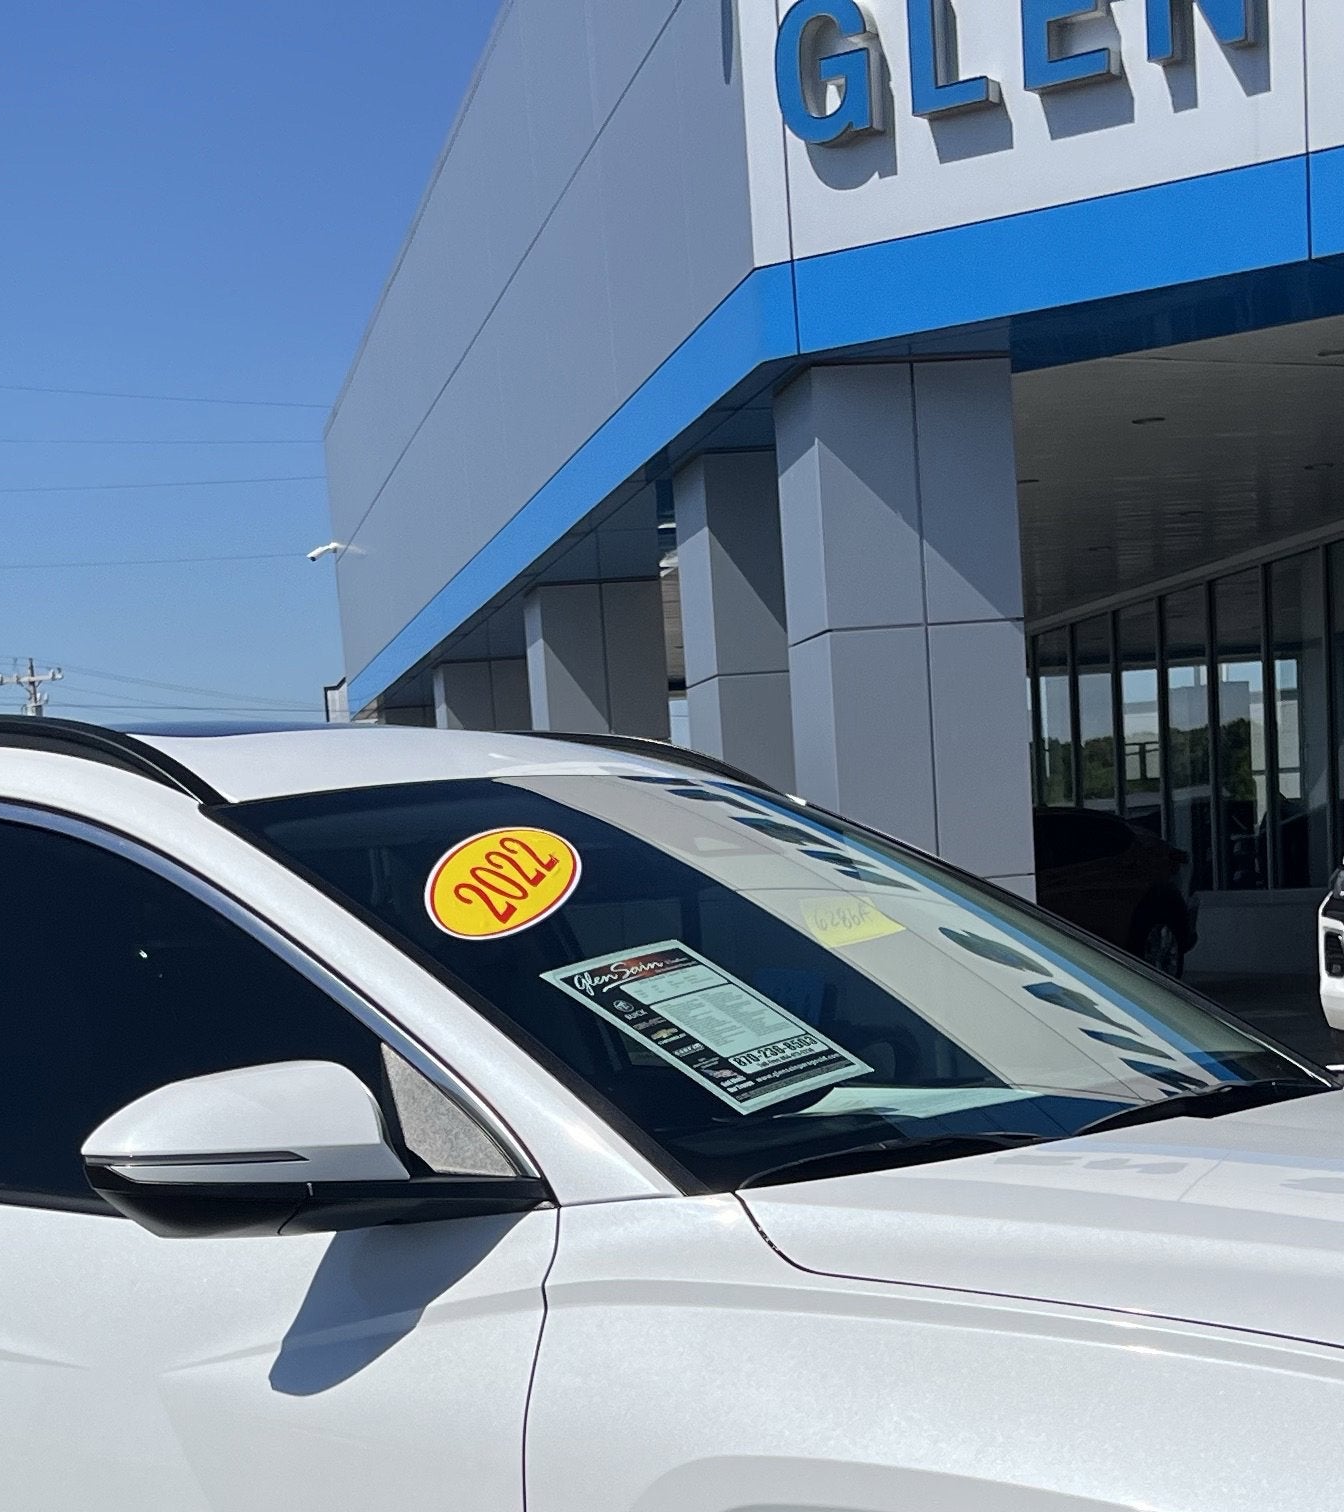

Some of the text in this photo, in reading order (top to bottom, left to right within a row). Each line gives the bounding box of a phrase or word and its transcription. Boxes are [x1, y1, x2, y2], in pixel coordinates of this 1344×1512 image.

[453, 837, 560, 925] 2022
[573, 971, 618, 997] Glen
[610, 960, 664, 979] Sain
